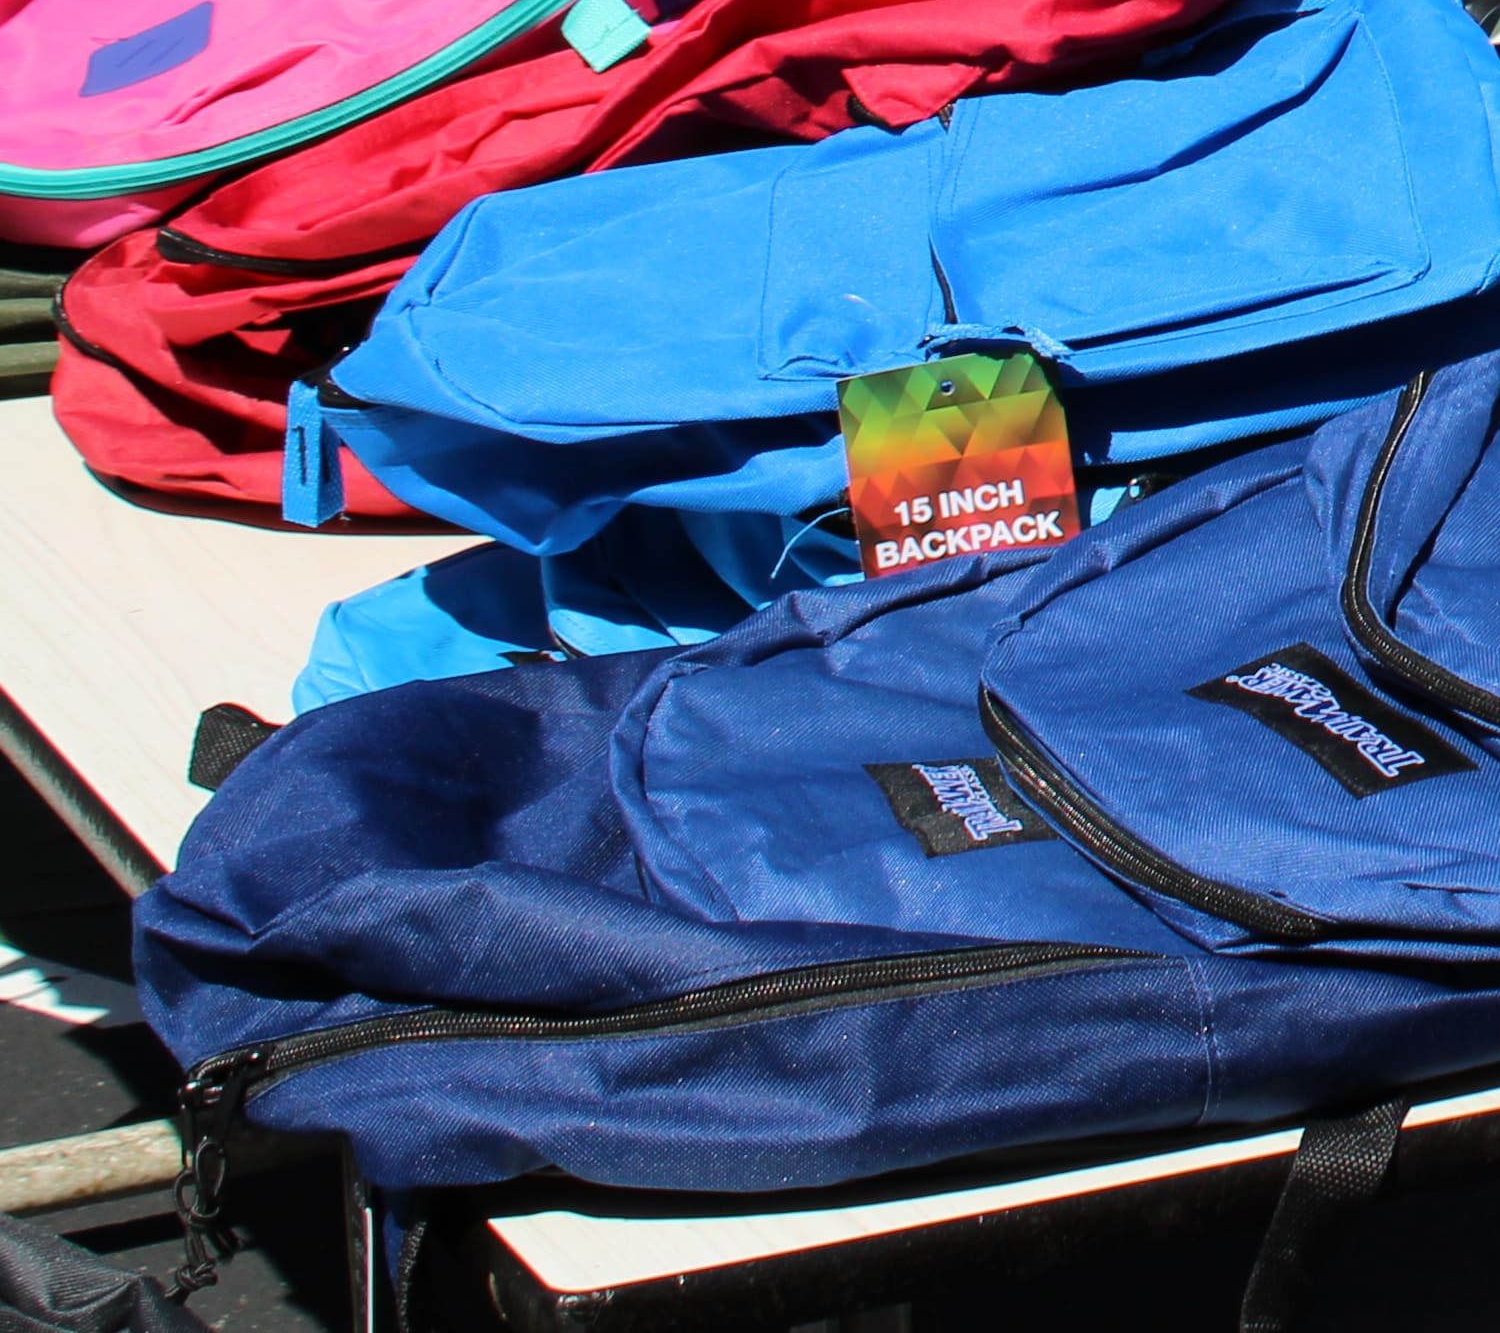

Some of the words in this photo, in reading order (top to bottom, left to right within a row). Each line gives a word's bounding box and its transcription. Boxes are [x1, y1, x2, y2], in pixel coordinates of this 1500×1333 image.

[893, 495, 935, 526] 15
[938, 479, 1025, 519] INCH
[875, 510, 1064, 569] BACKPACK
